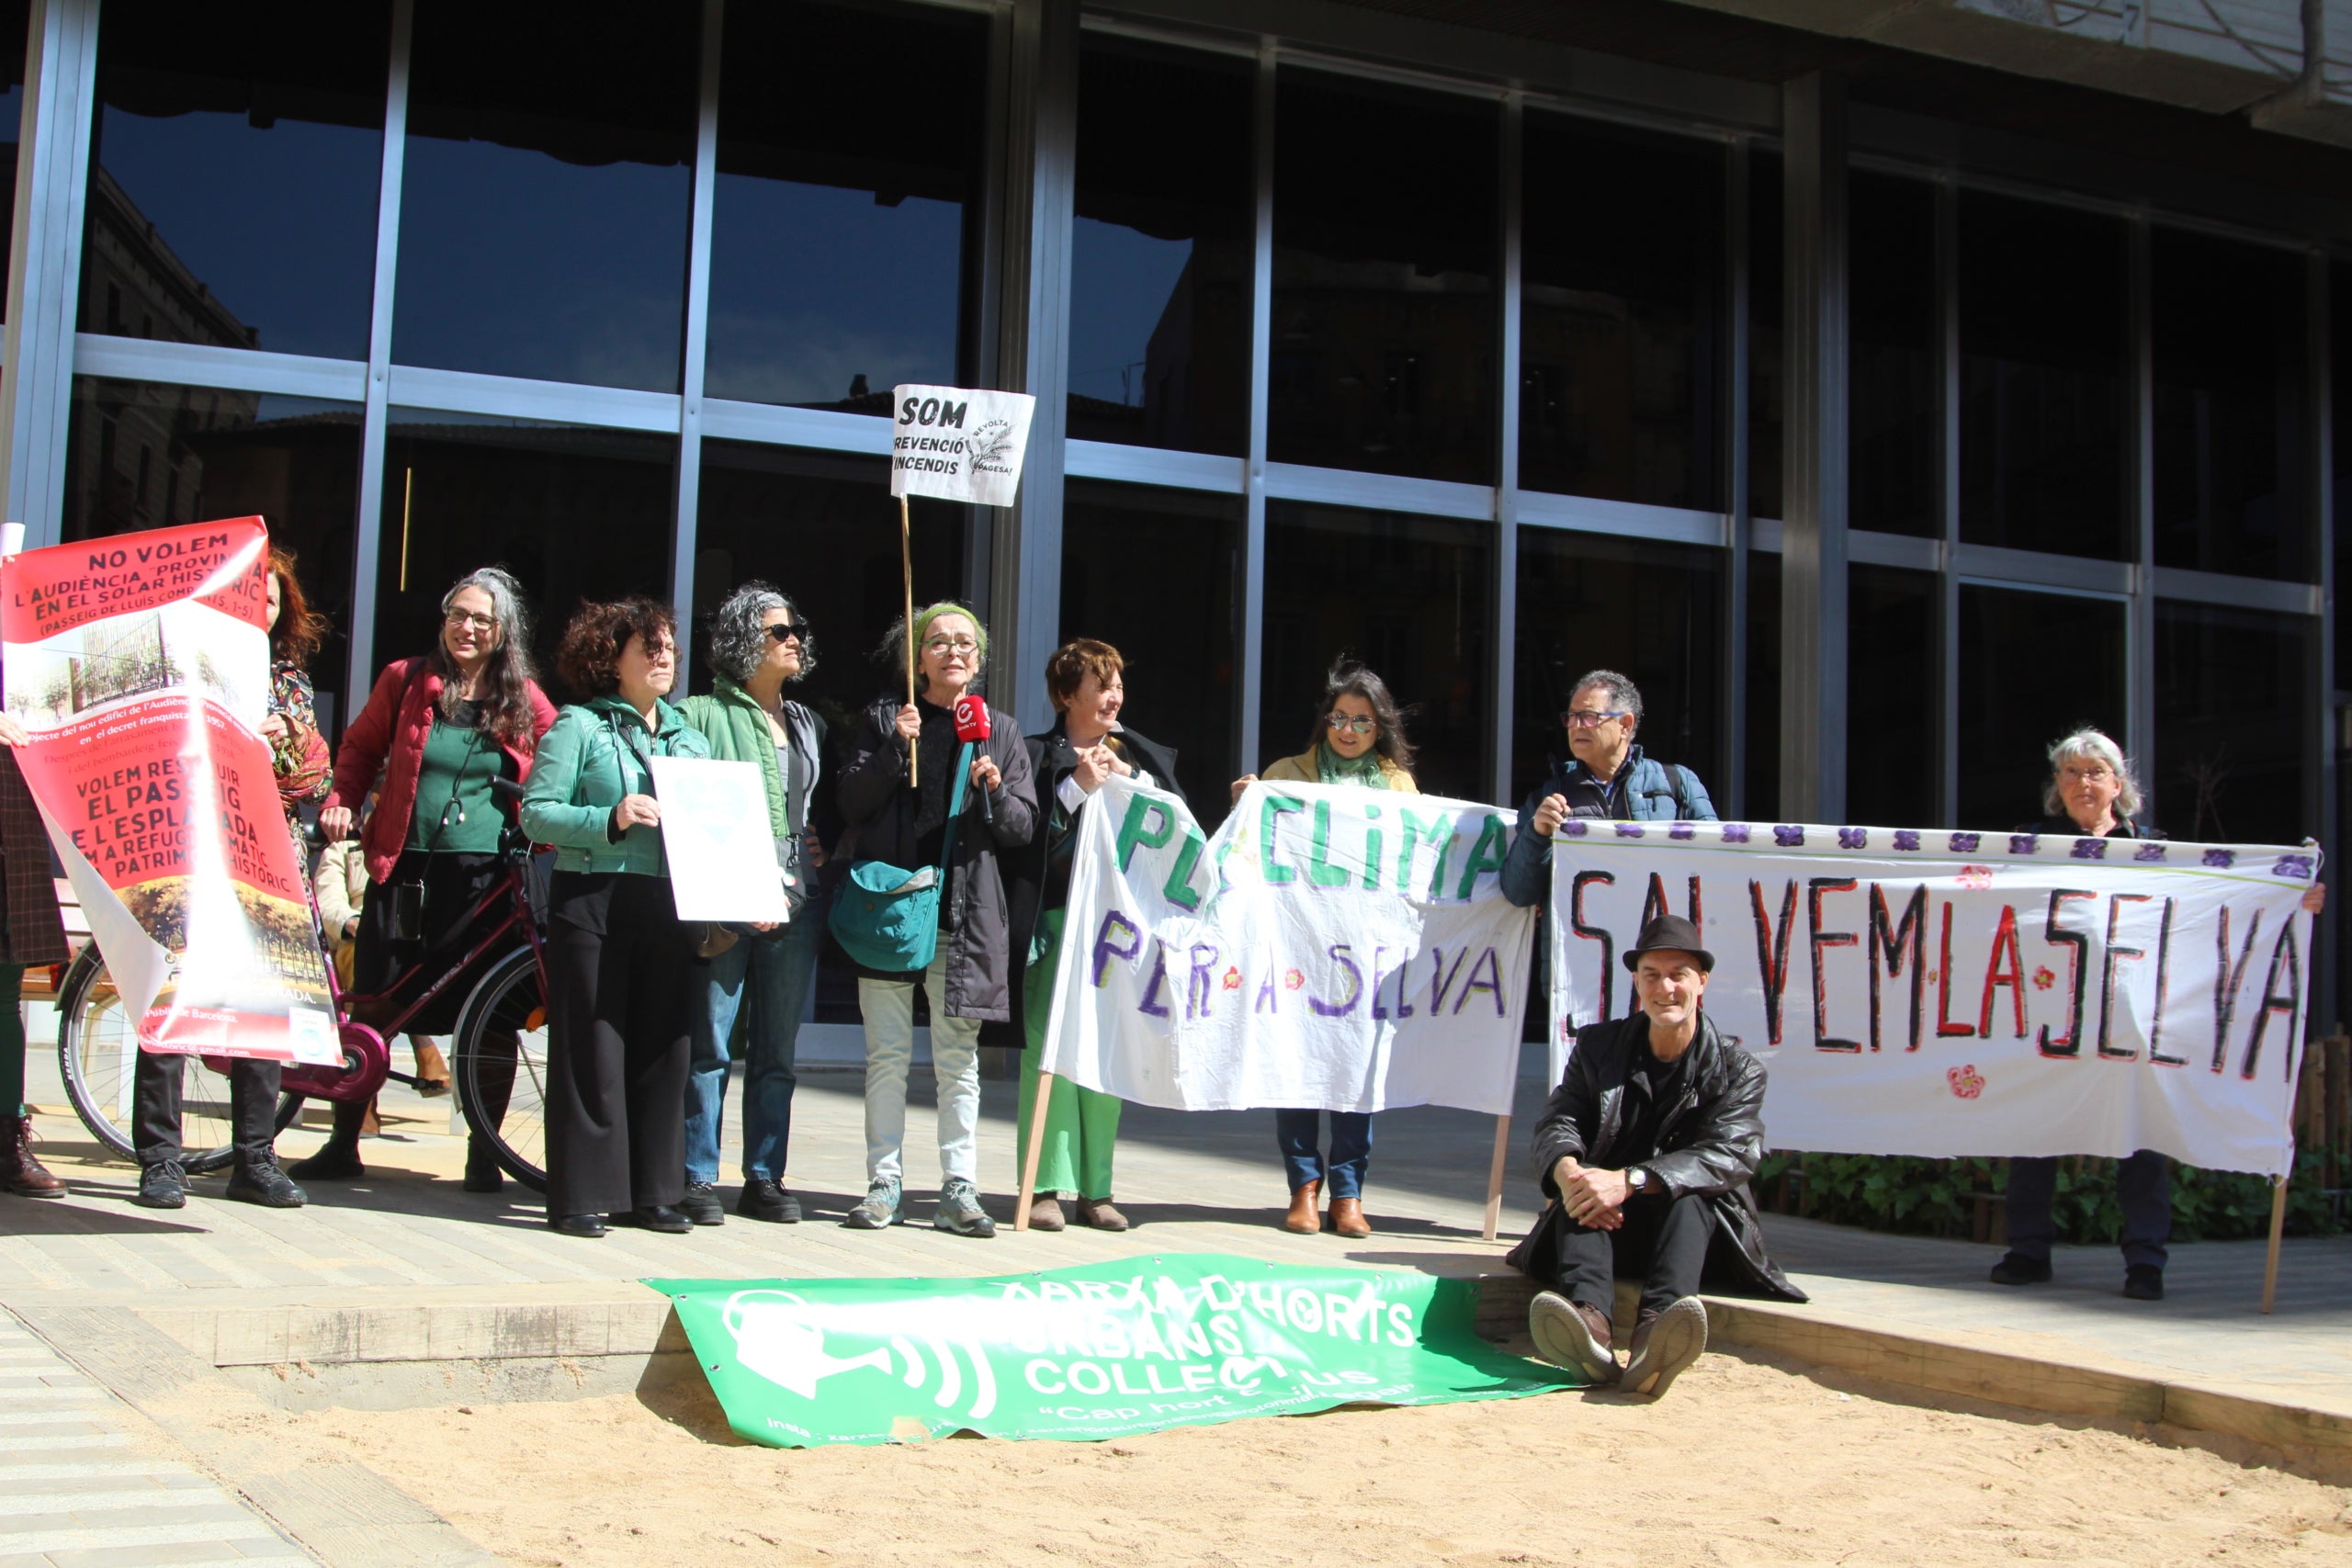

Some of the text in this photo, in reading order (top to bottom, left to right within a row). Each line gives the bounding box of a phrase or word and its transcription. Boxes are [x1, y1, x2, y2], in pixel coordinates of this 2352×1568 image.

[899, 397, 967, 429] SOM
[974, 420, 1009, 437] REVOLTA
[893, 435, 964, 455] REVENCIÓ
[88, 533, 228, 571] NO VOLEM
[35, 567, 260, 621] EN EL SOLAR HISRIC
[40, 585, 254, 637] (PASSEIG DE LLUÍS COMPYS, 1-5)
[28, 728, 60, 744] ojecte
[62, 724, 78, 738] del
[79, 719, 96, 731] nou
[98, 708, 129, 724] edifici
[130, 704, 141, 715] de
[79, 736, 92, 745] en
[96, 729, 107, 740] el
[107, 721, 137, 738] decret
[139, 710, 190, 730] franquista
[77, 757, 240, 798] VOLEM RESTUIR
[88, 779, 240, 821] EL PASIG
[71, 807, 259, 851] E L'ESPLAADA
[105, 845, 119, 861] A
[123, 829, 186, 855] REFUG
[115, 849, 187, 878] PATRIM
[1115, 792, 1236, 913] PL
[1307, 943, 1509, 1021] SELVA
[1936, 900, 2030, 1040] LA
[2036, 887, 2299, 1083] SELVA
[190, 1008, 238, 1023] Barcelona.
[62, 1047, 74, 1081] KENDA
[1198, 1274, 1415, 1348] D'HORTS
[1149, 1393, 1232, 1415] hort
[766, 1416, 811, 1439] Insta
